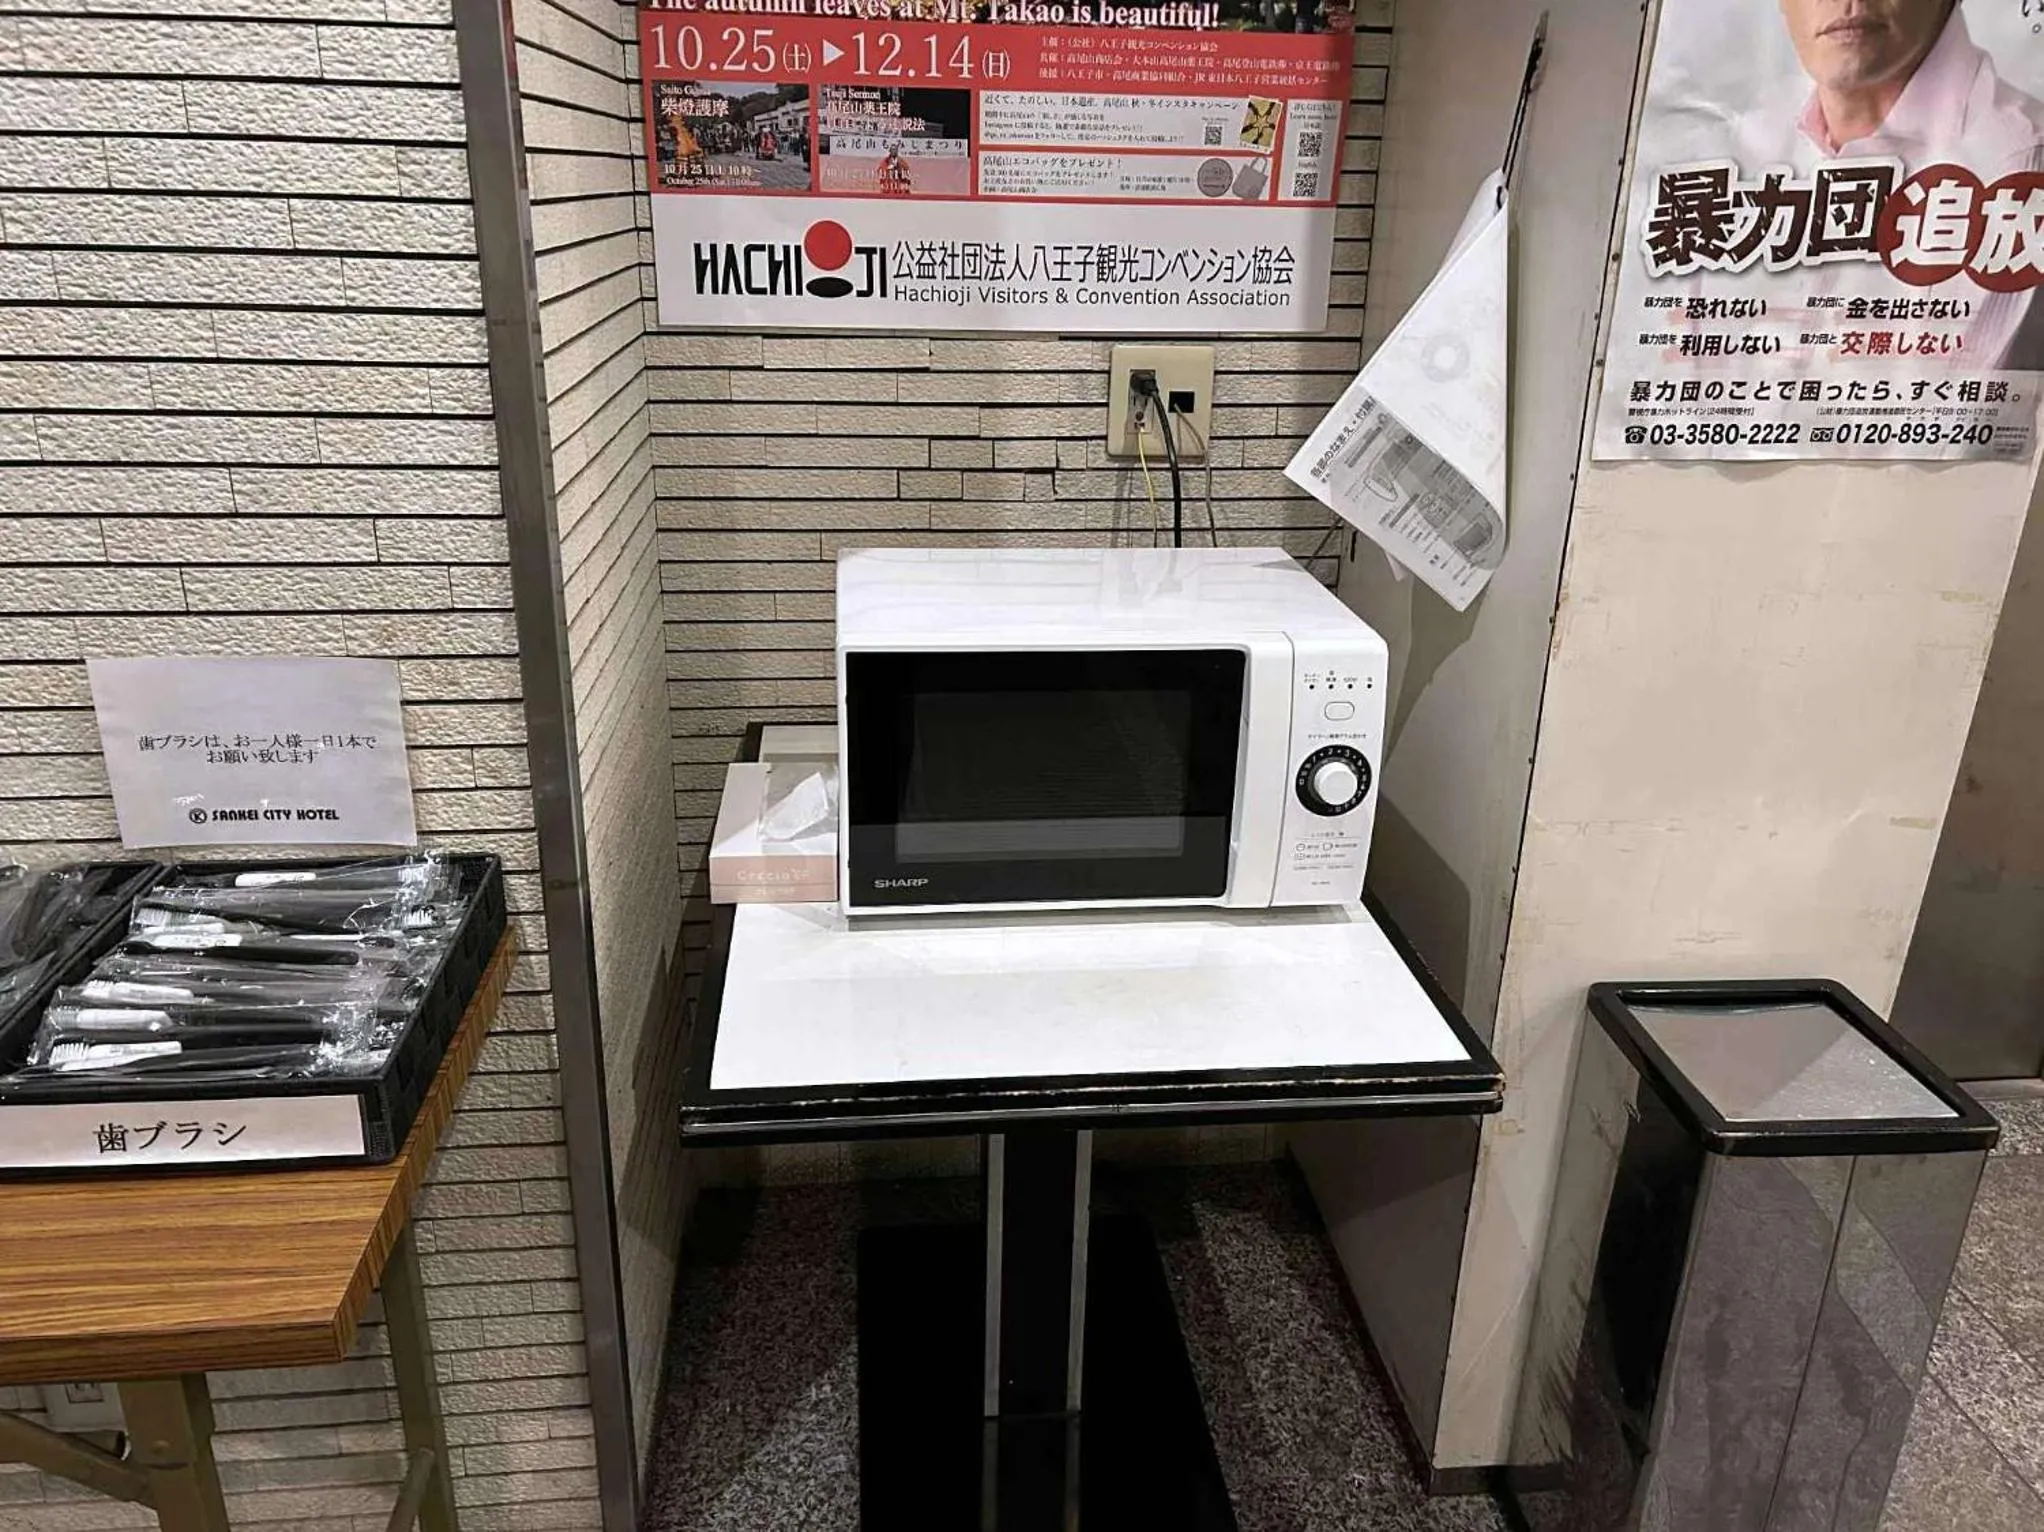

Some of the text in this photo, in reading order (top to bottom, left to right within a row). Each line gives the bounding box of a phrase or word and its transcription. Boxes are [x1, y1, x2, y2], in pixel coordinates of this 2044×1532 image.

[900, 0, 925, 18] at
[928, 0, 976, 21] Mt.
[988, 0, 1065, 23] Takao
[1072, 0, 1091, 23] is
[1099, 0, 1219, 28] beautiful!
[849, 89, 880, 100] Sermon
[892, 240, 1295, 285] 公益社団法人八王子観光コンベンション協会
[894, 284, 1290, 306] Hachioji Visitors & Convention Association
[1629, 380, 2021, 404] 暴力団のことで困ったら、すぐ相談。
[1650, 423, 1800, 445] 03-3580-2222
[1836, 423, 1993, 445] 0120-893-240
[138, 734, 377, 750] 歯ブラシは、お一人様一日1本で
[206, 749, 320, 765] お願い致します
[212, 809, 259, 821] SANKEI
[263, 809, 291, 820] CITY
[297, 809, 340, 820] HOTEL
[874, 878, 929, 889] SHARP
[93, 1121, 248, 1155] 歯ブラシ
